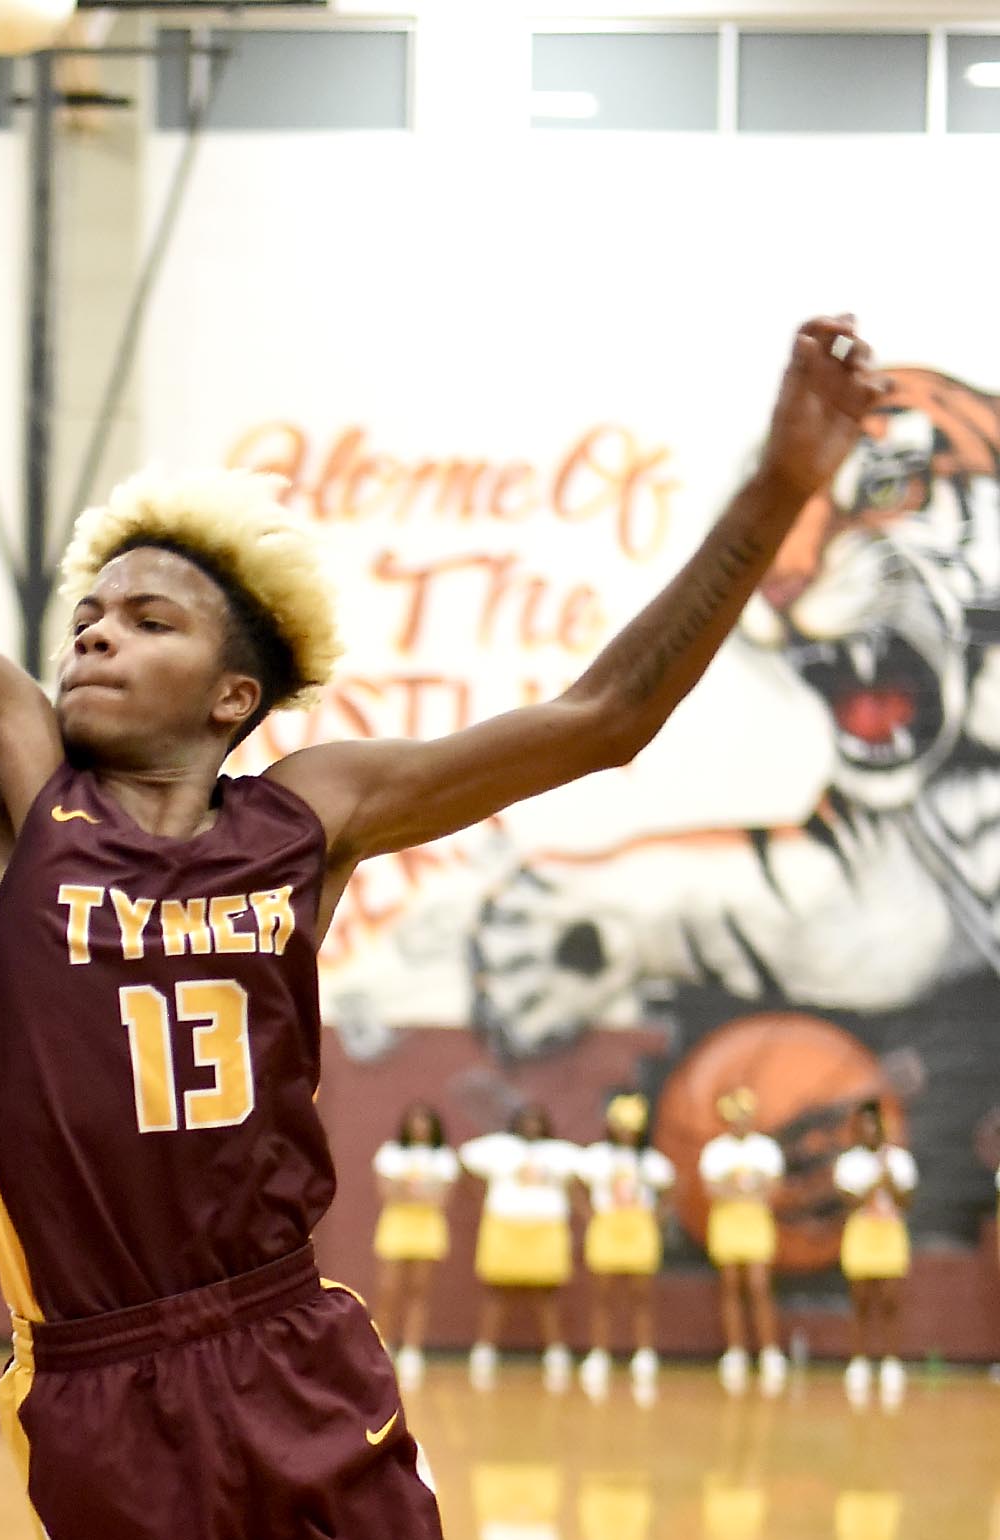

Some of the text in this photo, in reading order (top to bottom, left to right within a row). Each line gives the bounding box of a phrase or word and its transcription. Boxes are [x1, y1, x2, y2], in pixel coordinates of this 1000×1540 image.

[224, 420, 681, 561] Home Of
[370, 548, 608, 657] The
[57, 884, 296, 965] TYNER
[118, 978, 256, 1134] 13
